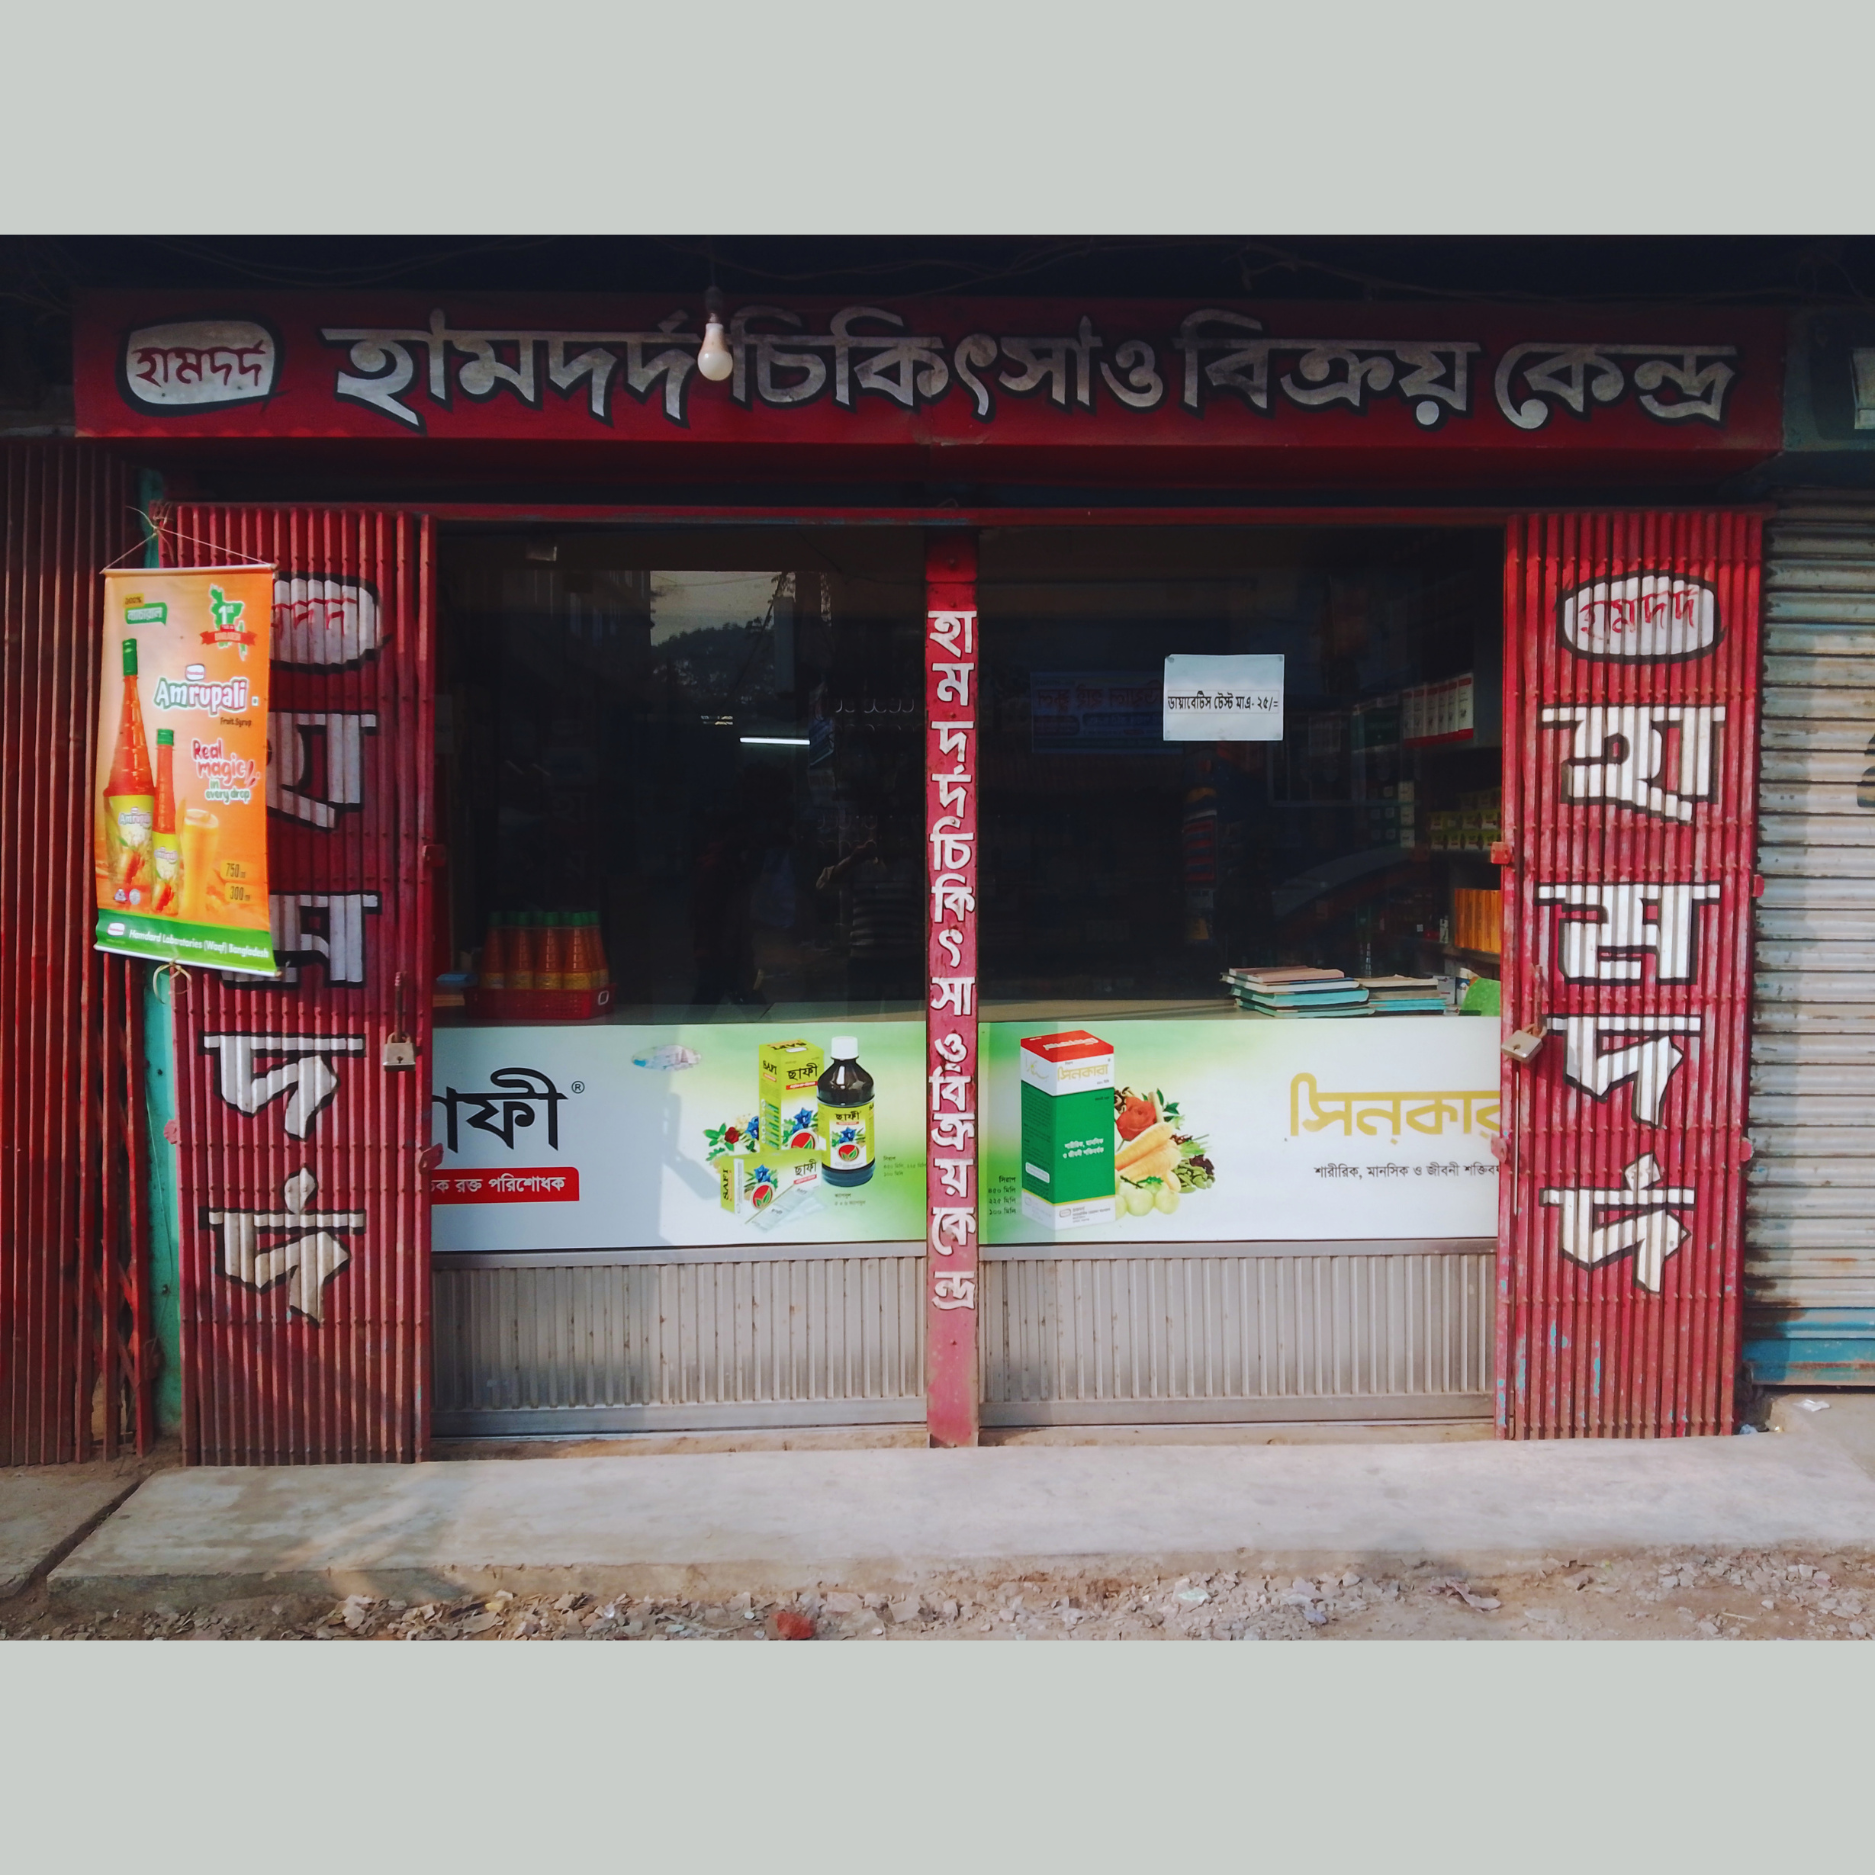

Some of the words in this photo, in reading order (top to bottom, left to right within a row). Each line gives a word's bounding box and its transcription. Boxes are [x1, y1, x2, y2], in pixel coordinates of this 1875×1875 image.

[131, 340, 268, 389] হামদর্দ
[320, 308, 697, 427] হামদর্দ
[1174, 308, 1483, 425] বিক্রয়
[1494, 342, 1738, 429] কেন্দ্র
[154, 677, 247, 716] Amrupali
[1168, 690, 1212, 709] ডায়াবেটিস
[1214, 692, 1235, 709] টেস্ট
[192, 739, 223, 761] Real
[197, 753, 247, 786] magic
[205, 790, 230, 804] every
[230, 787, 250, 804] drop
[225, 863, 240, 878] 750
[230, 886, 244, 901] 300
[128, 929, 161, 943] Hamdard
[162, 934, 203, 949] Laboratories
[229, 943, 270, 958] Bangladesh
[431, 1067, 569, 1154] াফী
[1314, 1163, 1363, 1180] শারীরিক,
[1366, 1162, 1409, 1178] মানসিক
[1412, 1166, 1423, 1177] ও
[1426, 1161, 1461, 1178] জীবনী
[454, 1178, 483, 1193] রক্ত
[488, 1172, 566, 1193] পরিশোধক
